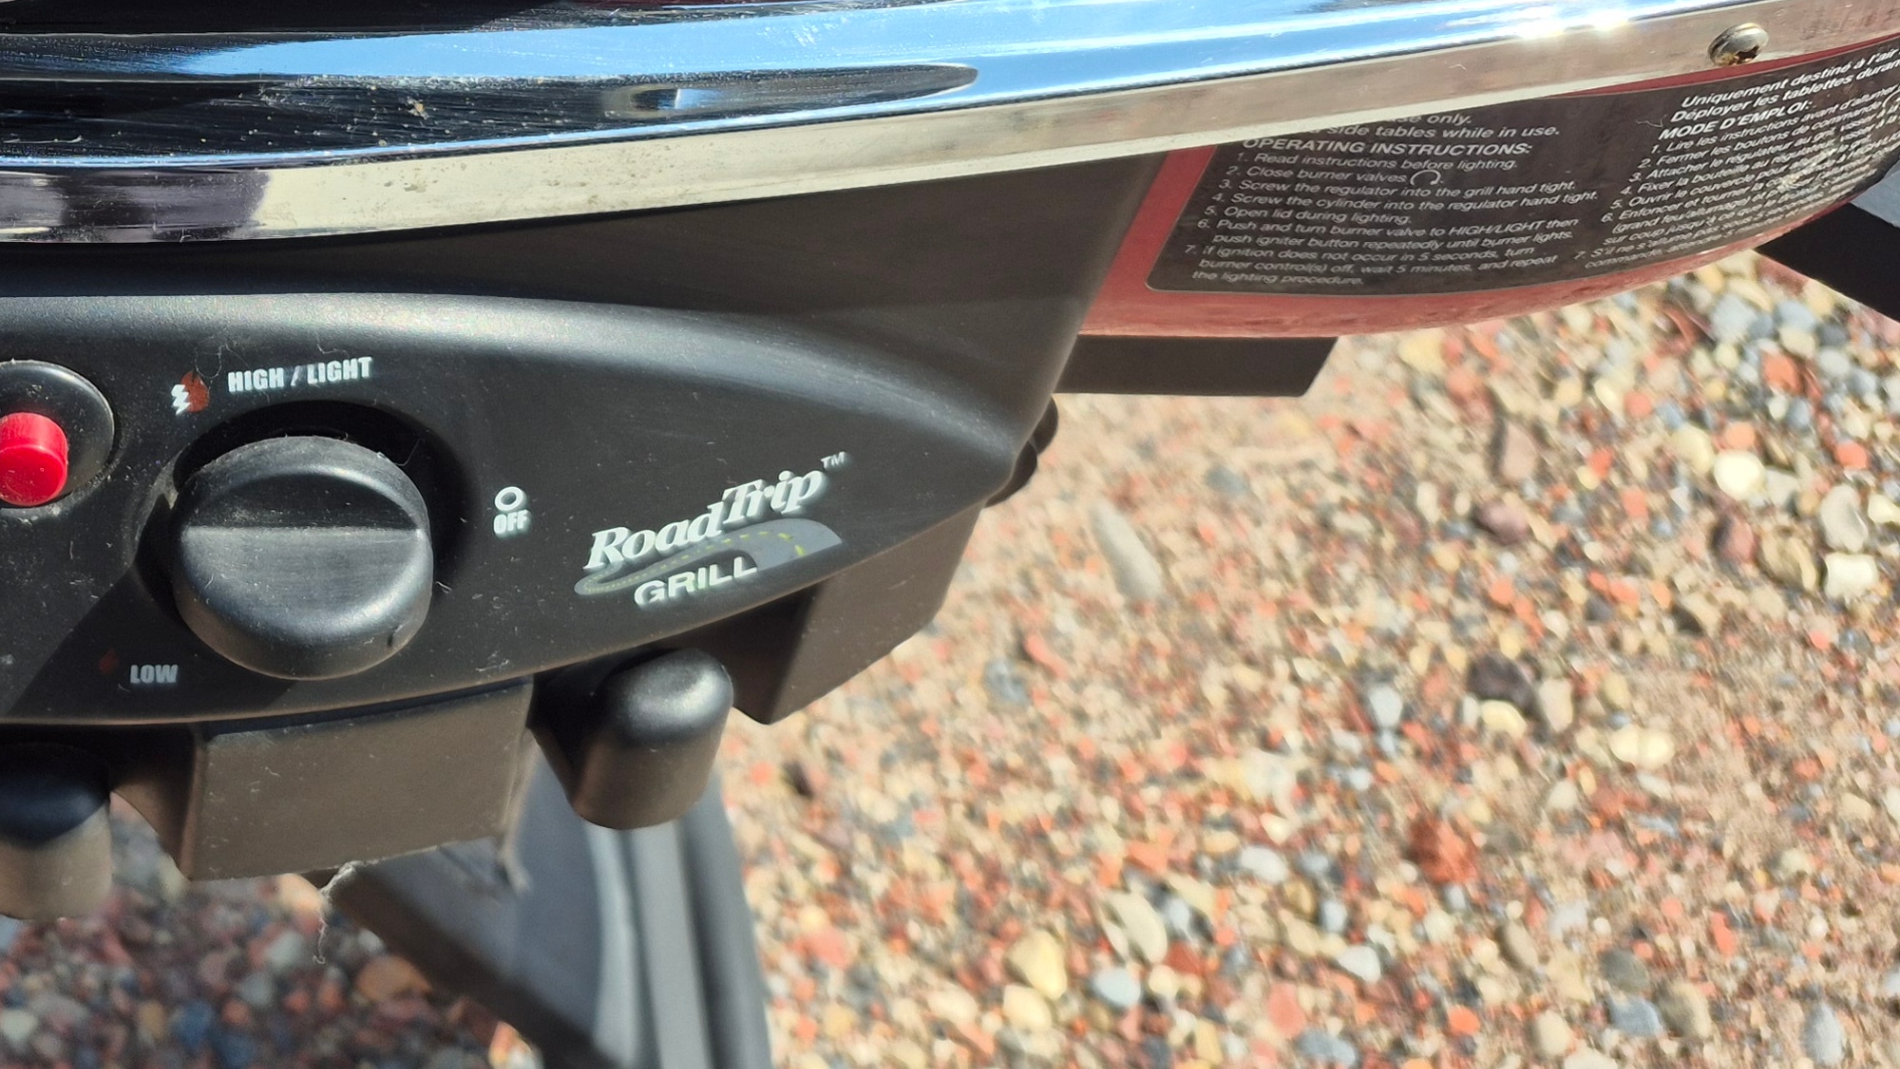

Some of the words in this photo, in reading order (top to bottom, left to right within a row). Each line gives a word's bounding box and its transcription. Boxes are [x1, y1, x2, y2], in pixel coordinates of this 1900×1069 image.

[1670, 100, 1752, 123] Déployer
[1753, 93, 1780, 107] les
[1783, 74, 1853, 101] tablettes
[1681, 78, 1789, 108] Uniquement
[1426, 113, 1473, 127] only.
[1658, 120, 1719, 140] MODE
[1720, 100, 1813, 129] D'EMPLOI:
[1327, 124, 1370, 136] side
[1375, 126, 1436, 138] tables
[1442, 126, 1495, 139] while
[1498, 126, 1517, 138] in
[1521, 126, 1560, 137] use.
[1666, 140, 1695, 152] Lire
[1696, 135, 1719, 147] les
[1720, 116, 1800, 142] instructions
[1242, 138, 1366, 154] OPERATING
[1369, 142, 1533, 157] INSTRUCTIONS:
[1254, 152, 1299, 165] Read
[1302, 155, 1397, 169] instructions
[1400, 159, 1453, 170] before
[1457, 159, 1518, 173] lighting.
[1657, 150, 1710, 166] Fermer
[1246, 166, 1294, 178] Close
[1297, 169, 1355, 181] burner
[1356, 172, 1407, 184] valves
[1238, 180, 1292, 192] Screw
[1294, 182, 1321, 193] the
[1324, 184, 1398, 197] regulator
[1400, 186, 1432, 198] into
[1435, 186, 1461, 198] the
[1464, 186, 1493, 199] grill
[1495, 183, 1538, 196] hand
[1540, 181, 1576, 194] tight.
[1230, 193, 1282, 205] Screw
[1285, 195, 1313, 206] the
[1316, 196, 1383, 210] cylinder
[1383, 200, 1415, 211] into
[1418, 200, 1445, 211] the
[1447, 199, 1518, 213] regulator
[1520, 194, 1559, 207] hand
[1562, 191, 1598, 205] tight.
[1224, 206, 1269, 218] Open
[1271, 207, 1294, 219] lid
[1295, 210, 1348, 224] during
[1216, 218, 1257, 231] Push
[1260, 221, 1294, 232] and
[1295, 223, 1327, 234] turn
[1329, 225, 1383, 237] burner
[1428, 226, 1445, 237] to
[1544, 218, 1580, 230] then
[1212, 234, 1252, 245] push
[1255, 236, 1305, 247] igniter
[1307, 238, 1360, 249] button
[1321, 250, 1349, 261] not
[1400, 252, 1415, 262] in
[227, 367, 285, 393] HIGH
[306, 356, 373, 386] LIGHT
[493, 509, 532, 537] OFF
[633, 556, 760, 608] GRILL
[129, 662, 179, 687] LOW
